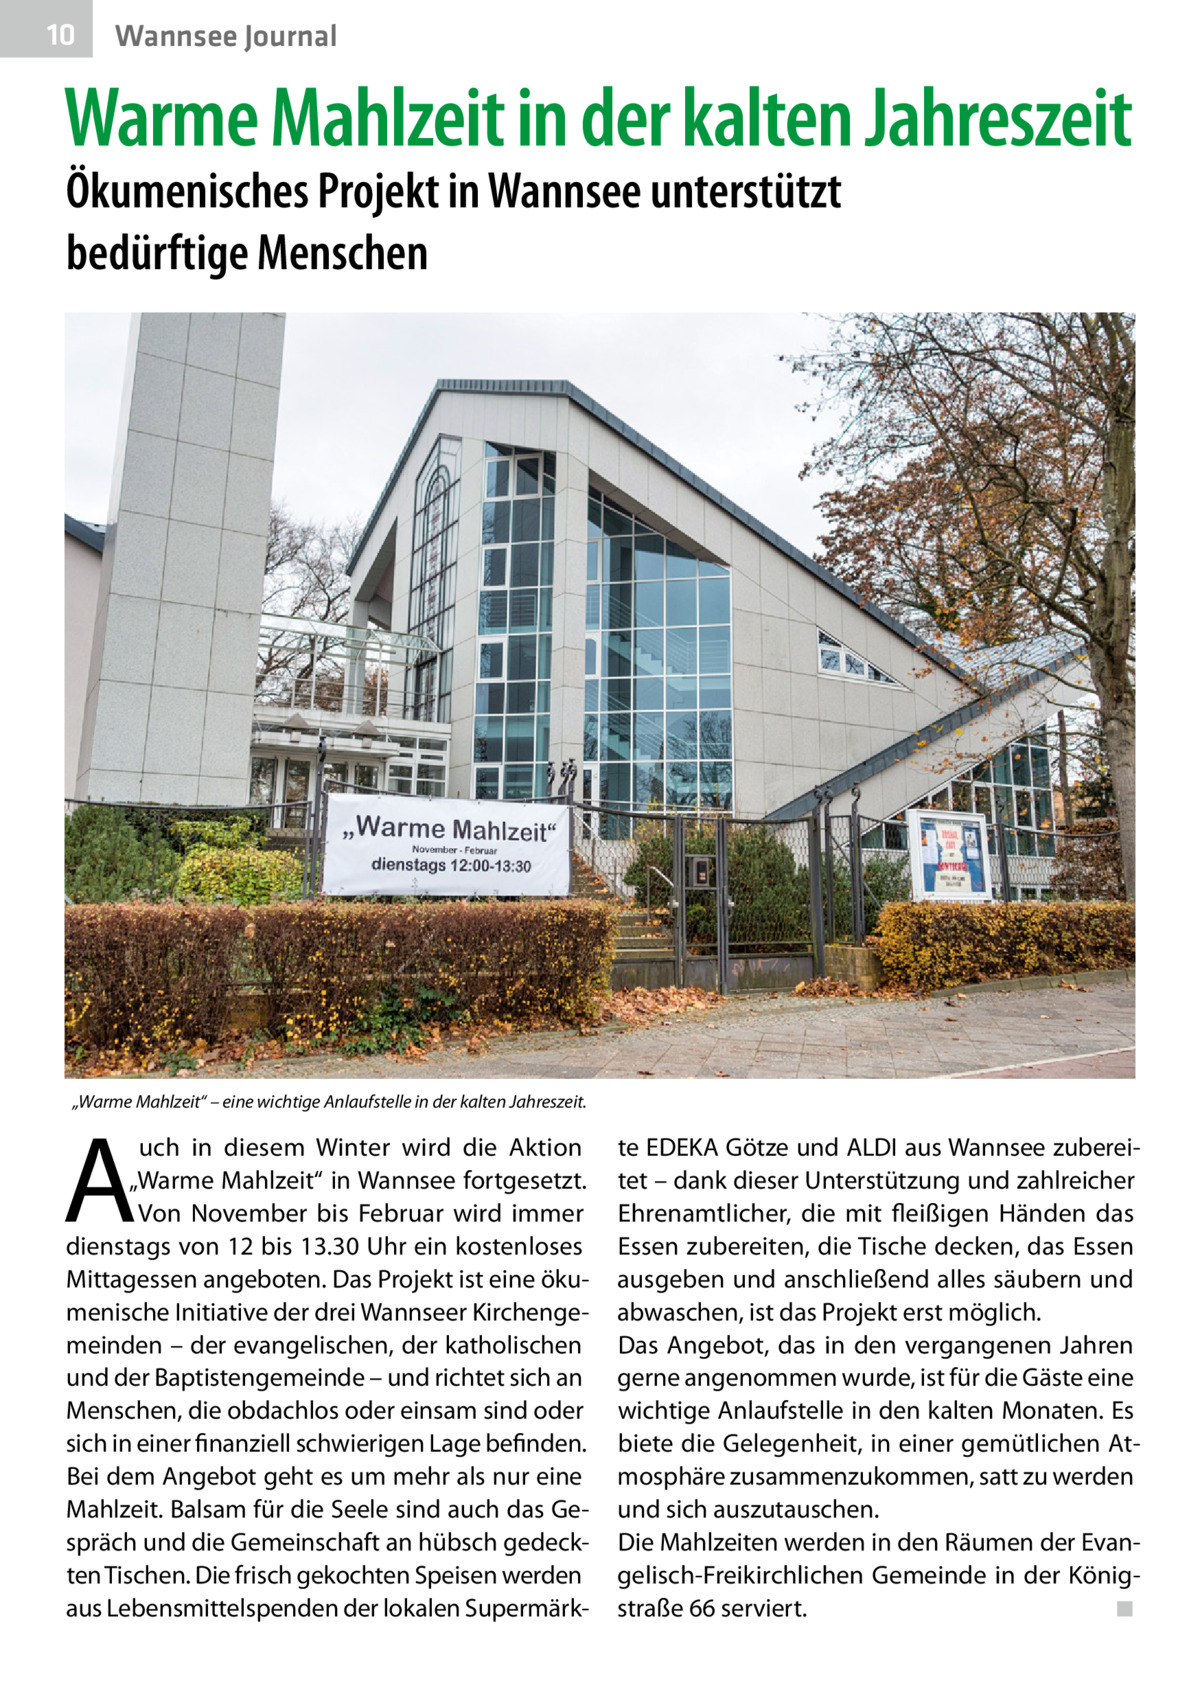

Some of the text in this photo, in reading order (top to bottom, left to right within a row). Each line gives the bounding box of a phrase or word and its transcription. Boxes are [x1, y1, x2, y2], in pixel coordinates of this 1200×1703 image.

[48, 24, 74, 45] 10
[115, 24, 336, 52] Wannsee Journal
[64, 86, 1132, 147] Warme Mahlzeit in der kalten Jahreszeit
[67, 164, 841, 218] Ökumenisches Projekt in Wannsee unterstützt
[68, 233, 427, 280] bedürftige Menschen
[342, 815, 557, 842] „Warme Mahlzeit“
[412, 845, 457, 854] November
[464, 846, 498, 855] Februar
[371, 857, 532, 874] dienstags 12:00-13:30
[72, 1095, 132, 1110] „Warme
[136, 1094, 207, 1108] Mahlzeit“
[223, 1095, 254, 1108] eine
[258, 1094, 320, 1112] wichtige
[324, 1094, 411, 1108] Anlaufstelle
[415, 1095, 428, 1108] in
[433, 1094, 457, 1108] der
[460, 1094, 506, 1108] kalten
[509, 1094, 586, 1108] Jahreszeit.
[193, 1138, 211, 1156] in
[224, 1137, 304, 1156] diesem
[316, 1138, 390, 1156] Winter
[402, 1137, 450, 1156] wird
[463, 1137, 497, 1156] die
[509, 1137, 581, 1156] Aktion
[618, 1137, 1140, 1156] te EDEKA Götze und ALDI aus Wannsee zuberei-
[130, 1170, 586, 1194] „Warme Mahlzeit“ in Wannsee fortgesetzt.
[138, 1203, 584, 1222] Von November bis Februar wird immer
[619, 1203, 1133, 1227] Ehrenamtlicher, die mit fleißigen Händen das
[619, 1236, 1133, 1258] Essen zubereiten, die Tische decken, das Essen
[67, 1269, 589, 1293] Mittagessen angeboten. Das Projekt ist eine öku-
[67, 1302, 589, 1326] menische Initiative der drei Wannseer Kirchenge-
[618, 1302, 1041, 1326] abwaschen, ist das Projekt erst möglich.
[67, 1400, 584, 1422] Menschen, die obdachlos oder einsam sind oder
[618, 1400, 1133, 1424] wichtige Anlaufstelle in den kalten Monaten. Es
[67, 1433, 586, 1457] sich in einer finanziell schwierigen Lage befinden.
[619, 1466, 1133, 1490] mosphäre zusammenzukommen, satt zu werden
[67, 1499, 589, 1518] Mahlzeit. Balsam für die Seele sind auch das Ge-
[619, 1499, 879, 1518] und sich auszutauschen.
[67, 1565, 581, 1589] ten Tischen. Die frisch gekochten Speisen werden
[618, 1565, 1140, 1589] gelisch-Freikirchlichen Gemeinde in der König-
[66, 1598, 589, 1622] aus Lebensmittelspenden der lokalen Supermärk-
[618, 1598, 807, 1617] straße 66 serviert.
